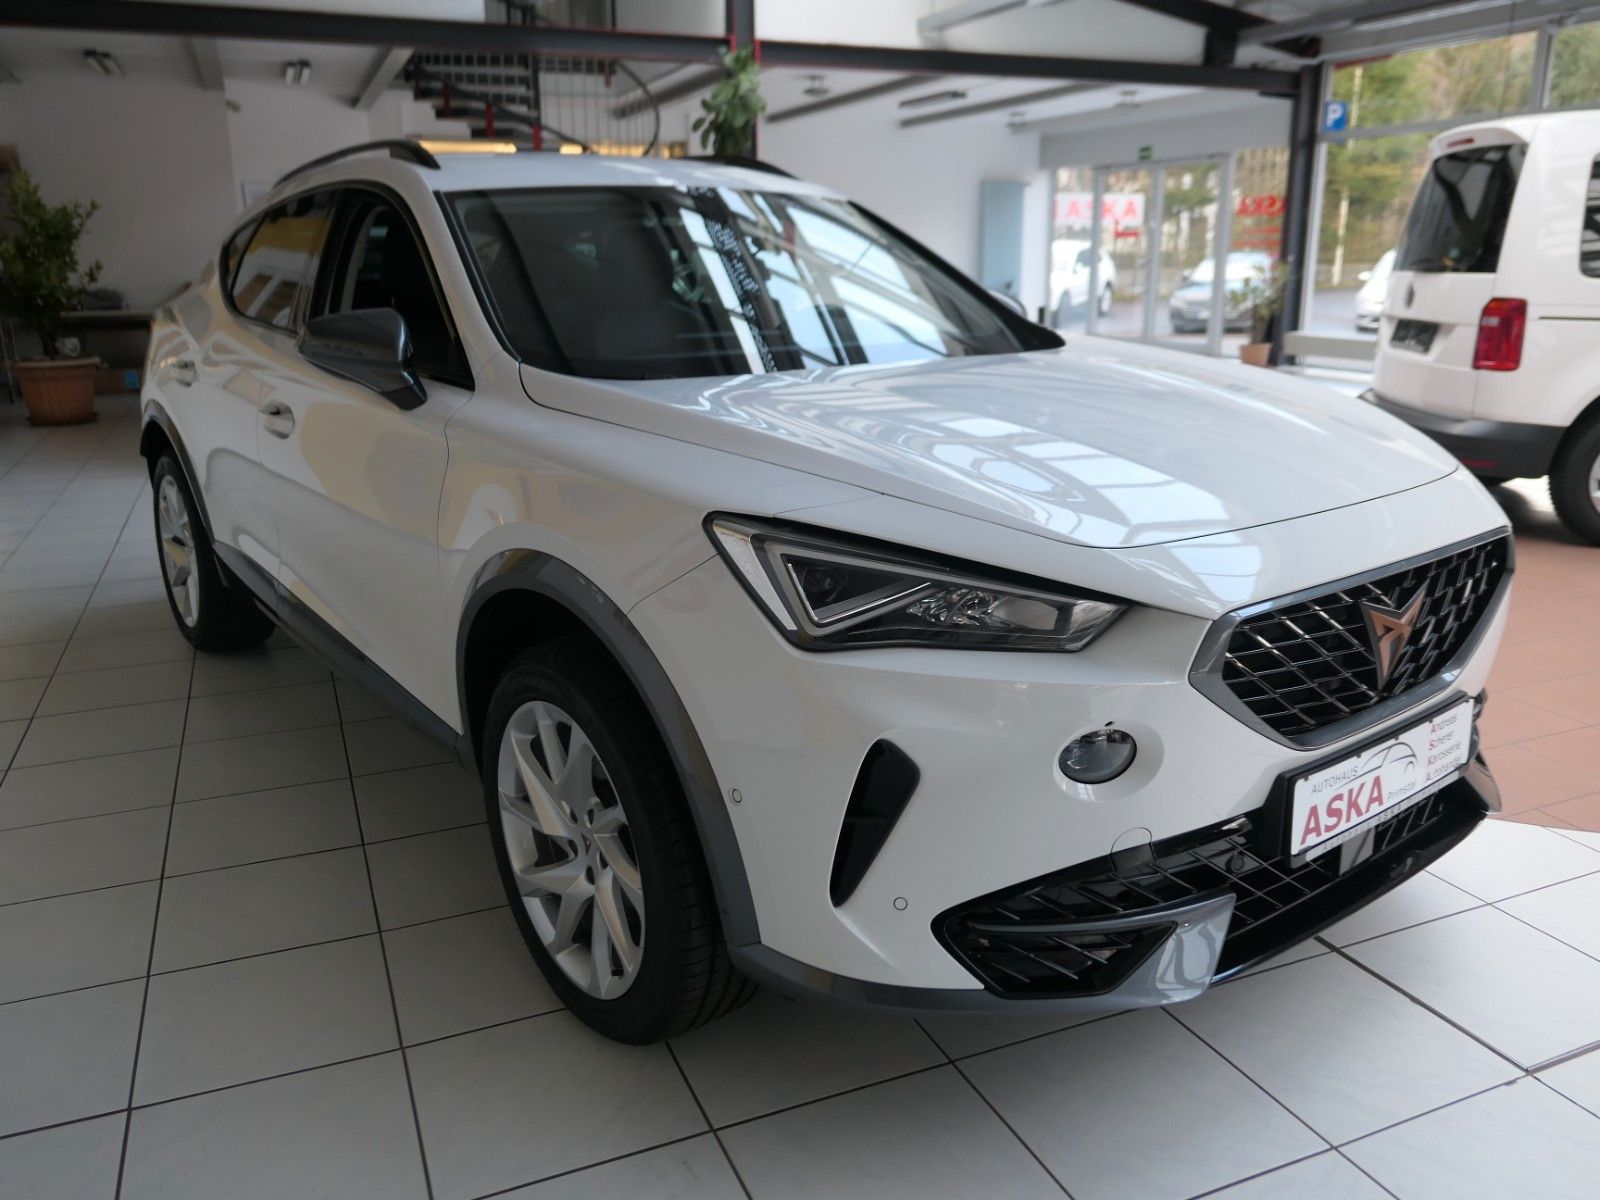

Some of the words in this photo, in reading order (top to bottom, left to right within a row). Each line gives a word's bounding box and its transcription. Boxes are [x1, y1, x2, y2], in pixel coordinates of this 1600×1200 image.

[1326, 103, 1343, 126] P
[1312, 766, 1359, 794] AUTOHAUS
[1300, 775, 1384, 846] ASKA
